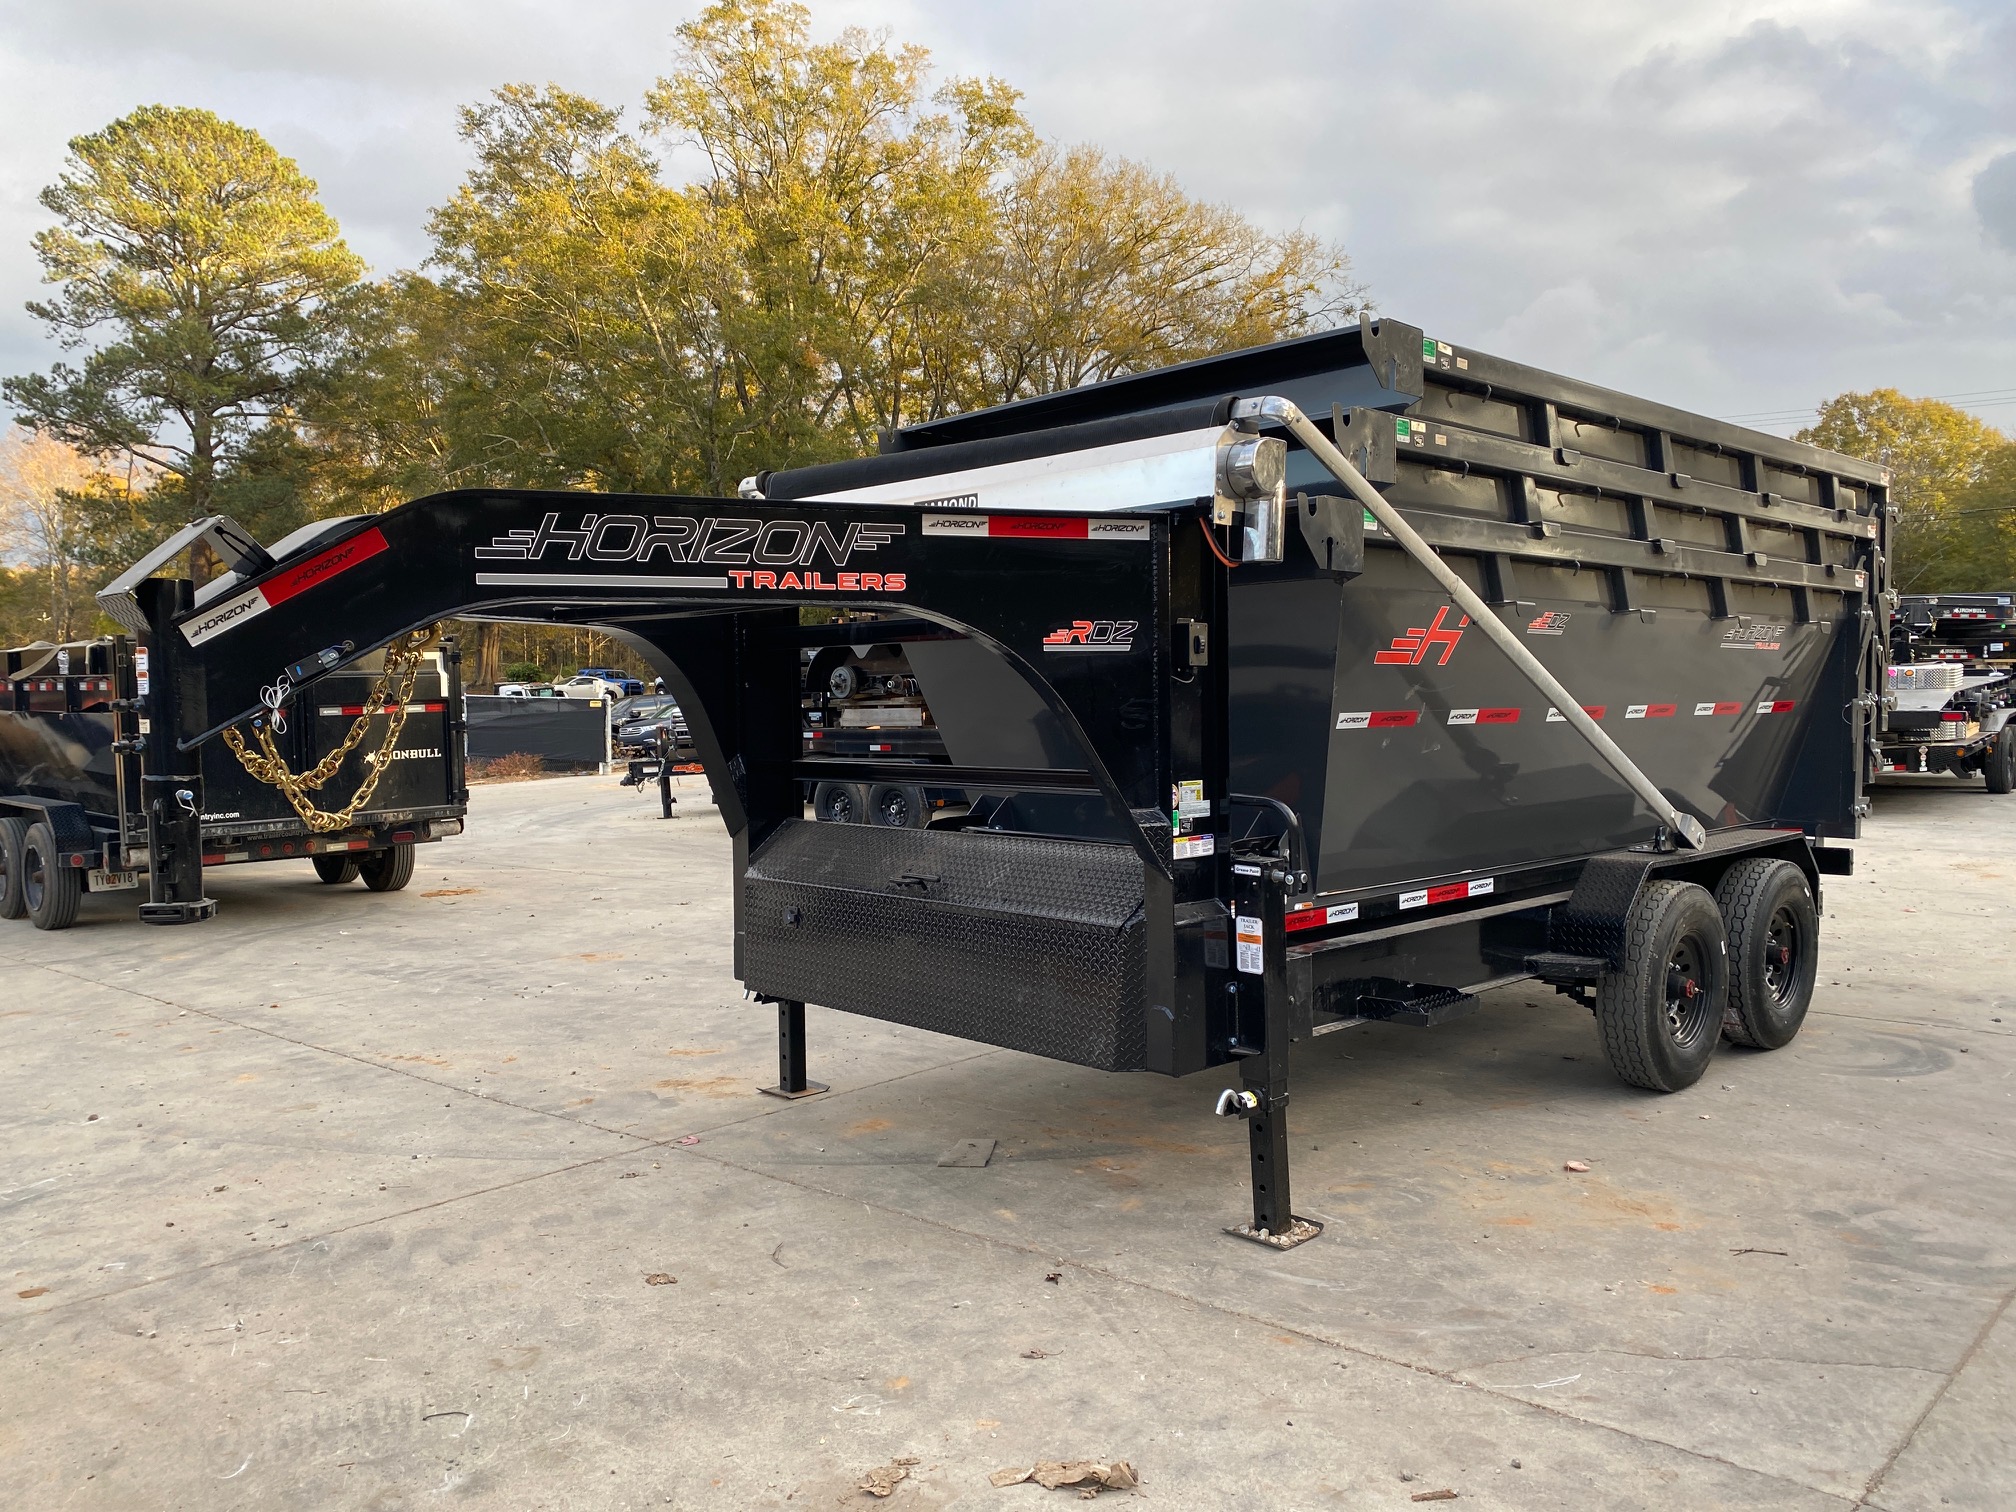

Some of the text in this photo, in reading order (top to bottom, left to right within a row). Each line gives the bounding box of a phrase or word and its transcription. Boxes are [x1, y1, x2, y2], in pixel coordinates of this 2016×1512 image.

[935, 519, 981, 530] HORIZON
[1097, 524, 1140, 533] HORIZON
[527, 512, 860, 566] HORIZON
[297, 551, 350, 583] HORIZON
[728, 569, 906, 591] TRAILERS
[198, 600, 252, 635] HORIZON
[1063, 620, 1138, 644] RDZ
[385, 748, 442, 760] ONBULL
[201, 811, 240, 822] ntryinc.com
